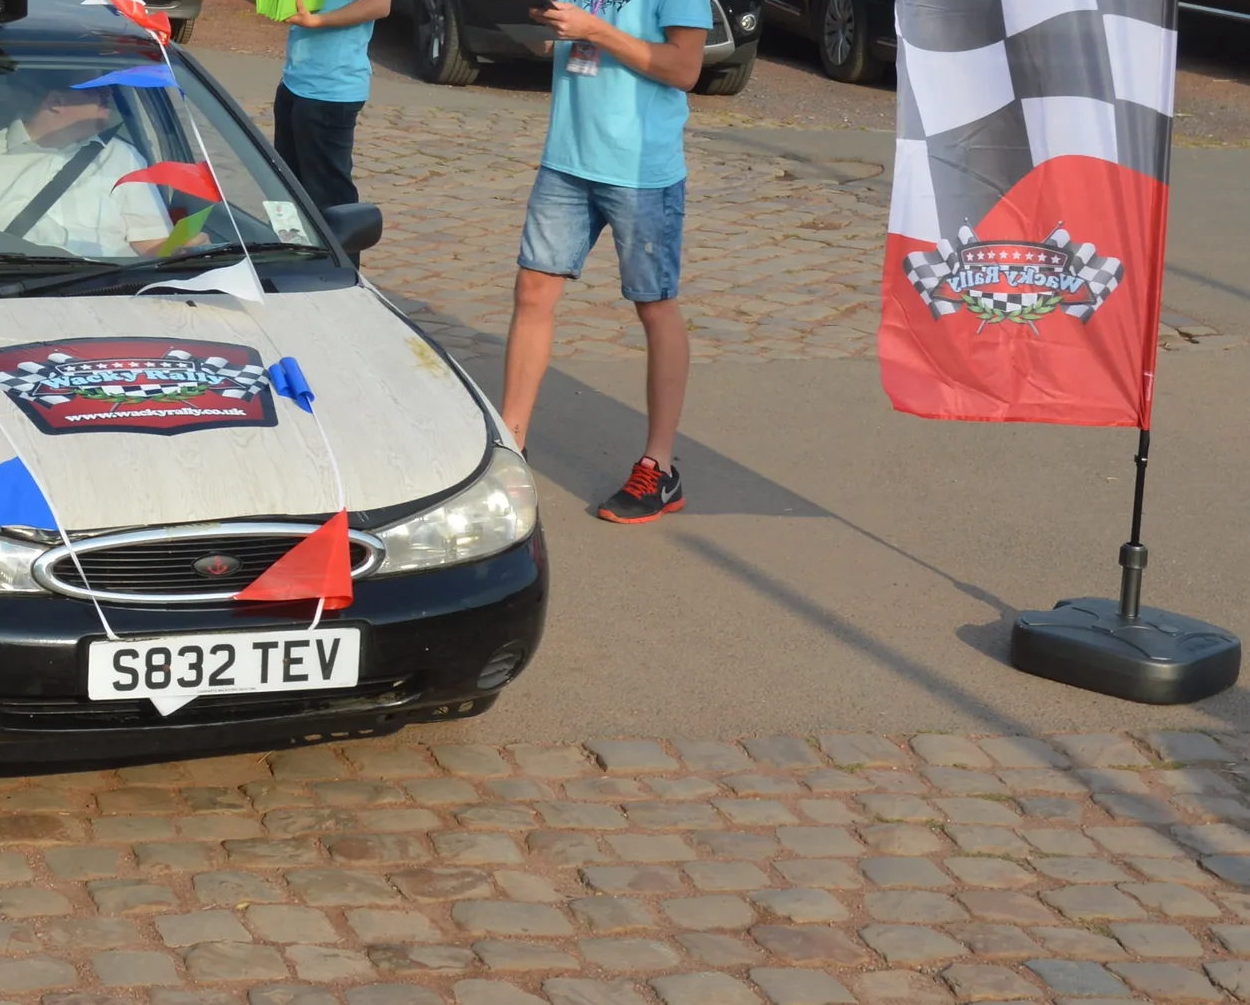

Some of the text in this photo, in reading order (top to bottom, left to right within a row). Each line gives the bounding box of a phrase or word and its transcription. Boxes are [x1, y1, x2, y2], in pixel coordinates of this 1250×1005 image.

[40, 369, 225, 390] Wacky Rally
[64, 407, 247, 423] www.wackyrally.co.uk
[112, 638, 341, 691] S832 TEV
